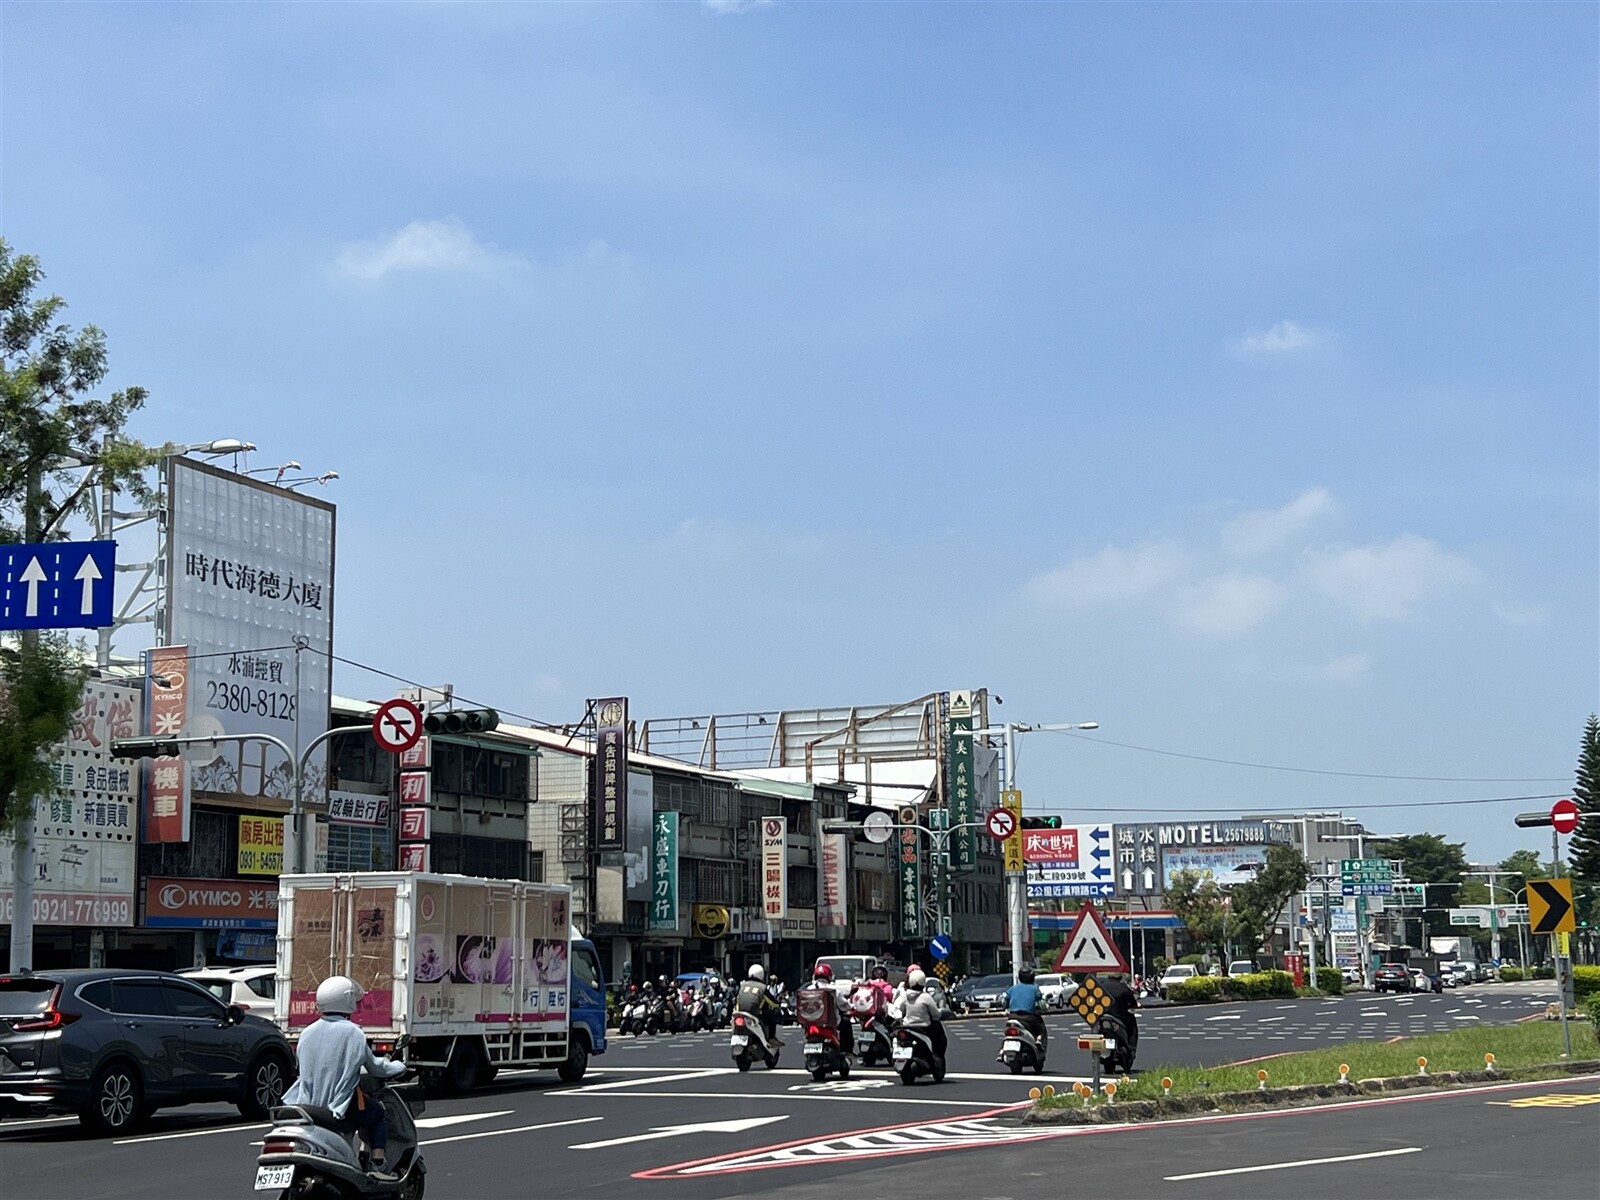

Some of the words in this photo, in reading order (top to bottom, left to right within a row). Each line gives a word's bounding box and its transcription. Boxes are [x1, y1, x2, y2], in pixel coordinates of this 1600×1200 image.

[153, 712, 182, 818] 光機車
[764, 839, 783, 847] SYM
[1026, 834, 1075, 852] 床的世界
[1158, 824, 1224, 845] MOTEL
[655, 814, 671, 919] 永盛車刀行
[822, 842, 839, 908] YAMAHA
[766, 852, 781, 914] 三陽機車
[33, 898, 129, 922] 0921-776999
[188, 890, 242, 907] KYMCO
